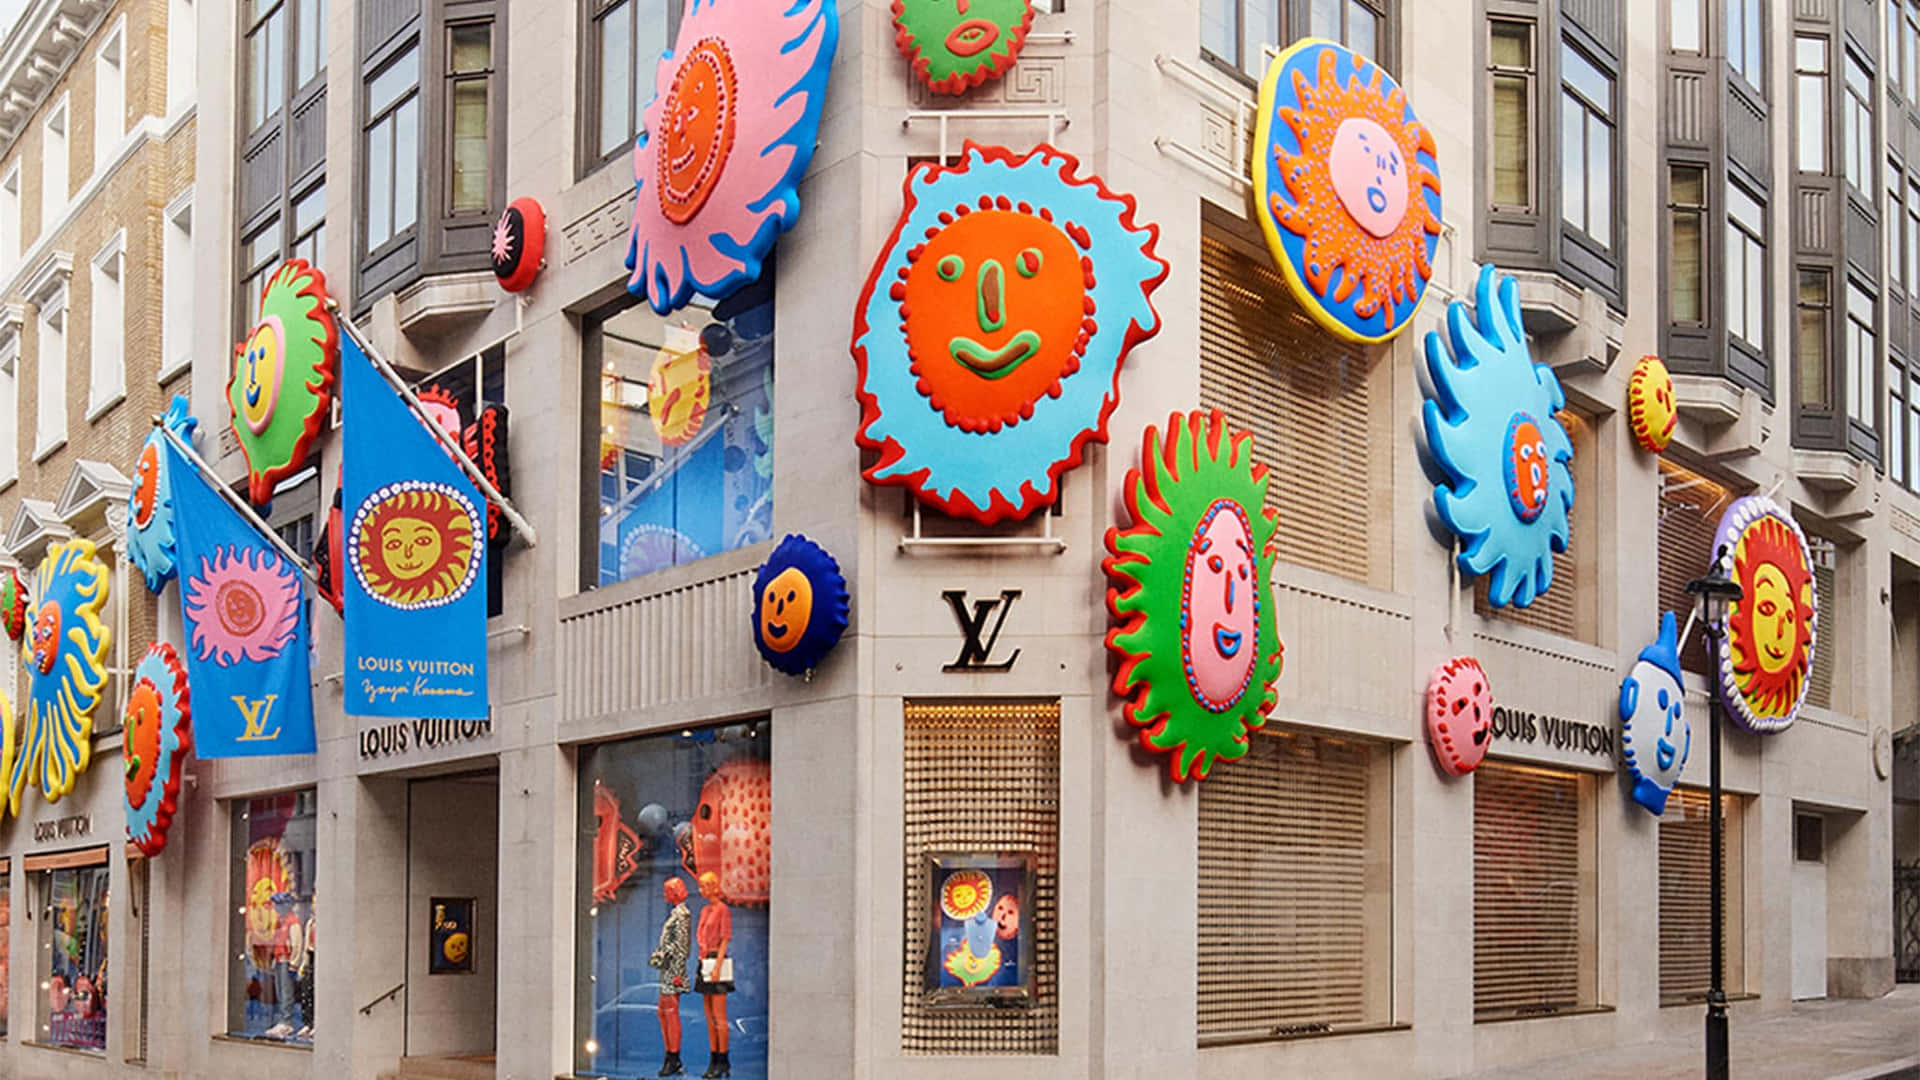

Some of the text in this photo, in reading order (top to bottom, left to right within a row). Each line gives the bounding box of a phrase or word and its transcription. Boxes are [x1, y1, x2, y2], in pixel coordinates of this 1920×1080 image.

[358, 656, 475, 676] LOUIS VUITTON
[360, 722, 409, 757] LOUIS
[1490, 706, 1615, 757] OUIS VUITTON
